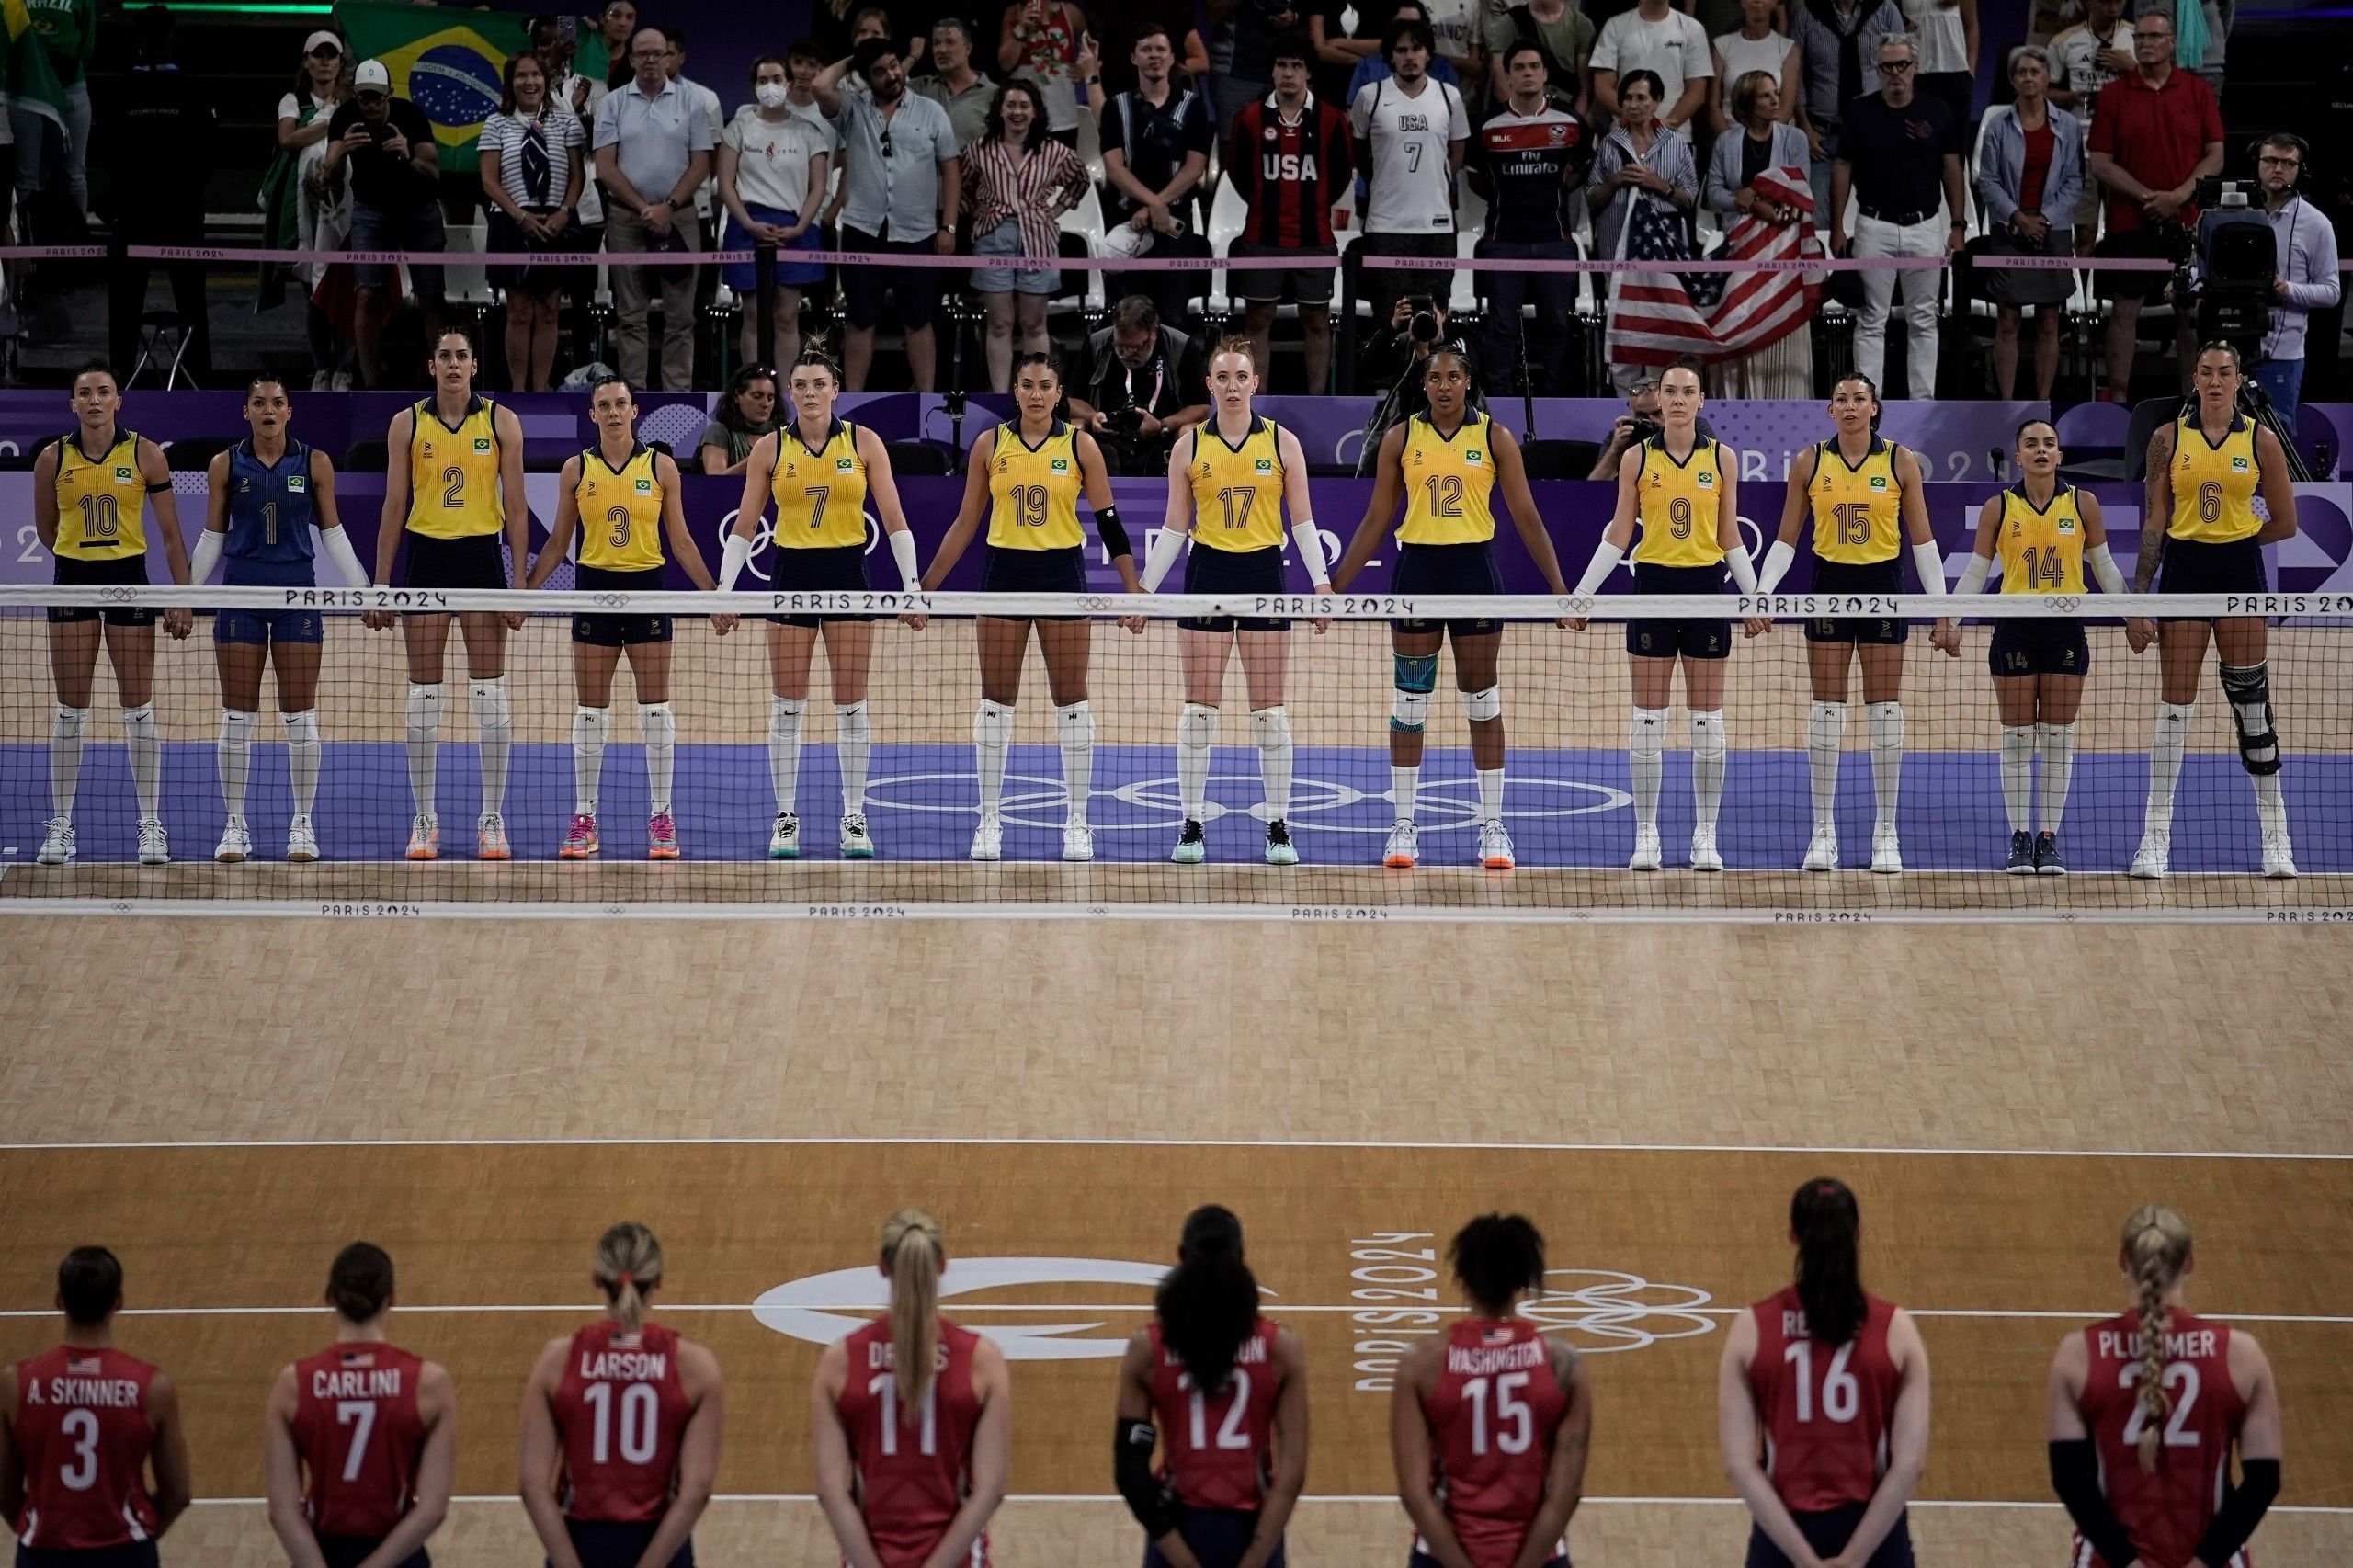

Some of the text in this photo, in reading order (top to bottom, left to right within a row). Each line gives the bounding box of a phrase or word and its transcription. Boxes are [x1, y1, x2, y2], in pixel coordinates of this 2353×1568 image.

[1397, 114, 1429, 132] USA
[1262, 153, 1319, 182] USA
[1404, 142, 1423, 173] 7
[1501, 162, 1559, 176] Emirates
[1521, 151, 1541, 162] Fly
[442, 466, 465, 508] 2
[804, 485, 830, 528] 7
[1009, 484, 1048, 528] 19
[1216, 486, 1256, 529] 17
[1424, 474, 1463, 517] 12
[2200, 481, 2222, 524] 6
[77, 494, 118, 538] 10
[260, 501, 277, 545] 1
[607, 506, 630, 548] 3
[1669, 497, 1692, 540] 9
[1830, 503, 1870, 545] 15
[2021, 545, 2064, 590] 14
[376, 590, 447, 607] 2024
[863, 594, 932, 610] 2024
[1344, 597, 1414, 614] 2024
[1828, 597, 1899, 614] 2024
[376, 904, 420, 915] 2024
[862, 906, 904, 917] 2024
[1345, 908, 1387, 919] 2024
[1828, 912, 1871, 922] 2024
[1349, 1232, 1438, 1301] 2024
[1448, 1335, 1546, 1376] WASHINGTON
[2098, 1329, 2217, 1359] PLUMER
[313, 1368, 401, 1400] CARLINI
[580, 1350, 667, 1381] LARSON
[1783, 1340, 1860, 1424] 16
[27, 1377, 140, 1408] A. SKINNER
[1176, 1367, 1252, 1450] 12
[2117, 1361, 2201, 1448] 22
[583, 1381, 659, 1466] 10
[1461, 1371, 1533, 1457] 15
[60, 1407, 100, 1492] 3
[336, 1400, 377, 1483] 7
